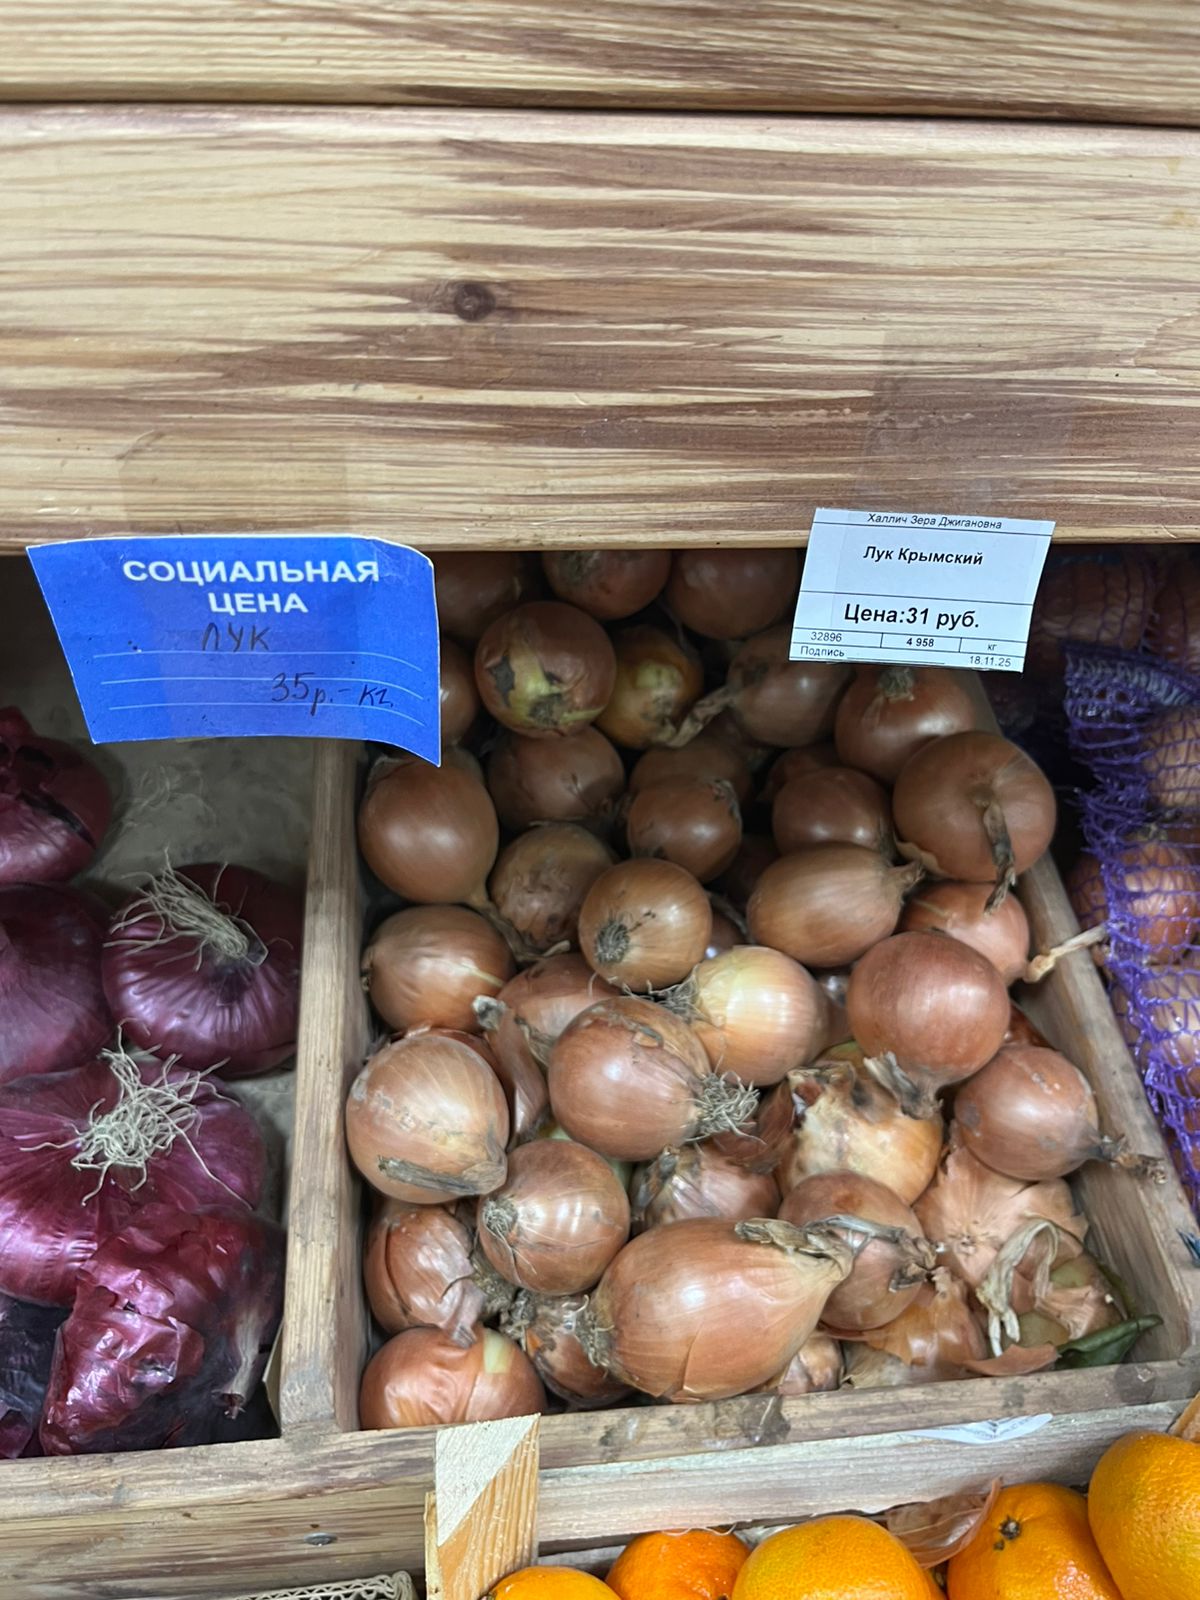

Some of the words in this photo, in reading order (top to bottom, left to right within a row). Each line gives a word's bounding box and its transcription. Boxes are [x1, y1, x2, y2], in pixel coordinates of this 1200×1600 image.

[867, 513, 908, 524] Халлич
[910, 515, 936, 526] Зера
[938, 516, 1003, 529] Джигановна
[863, 546, 894, 563] Лук
[897, 547, 983, 565] Крымский
[122, 559, 380, 587] СОЦИАЛЬНАЯ
[208, 592, 308, 616] ЦЕНА
[844, 603, 929, 624] Цена:31
[936, 610, 979, 631] руб.
[810, 631, 843, 642] 32896
[800, 645, 845, 657] Подпись
[987, 643, 998, 651] кг
[969, 655, 1012, 667] 18.11.25
